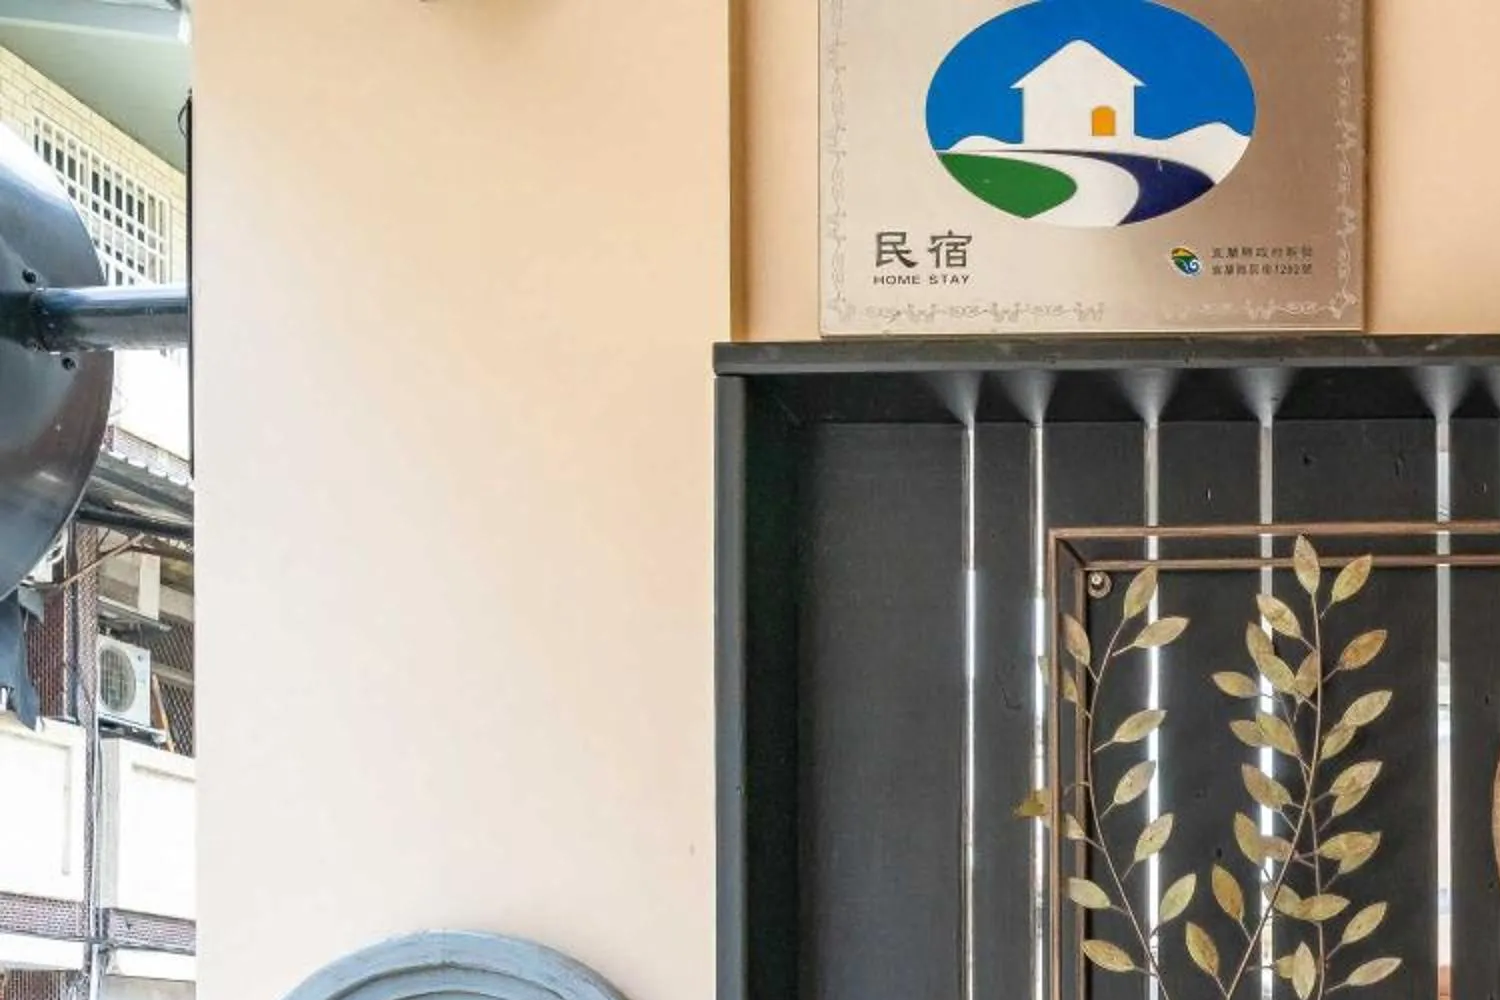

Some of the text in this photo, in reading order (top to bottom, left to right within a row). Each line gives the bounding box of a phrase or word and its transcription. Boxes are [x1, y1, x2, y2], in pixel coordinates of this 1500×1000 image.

[876, 230, 972, 268] 民宿
[873, 275, 969, 285] HOME STAY
